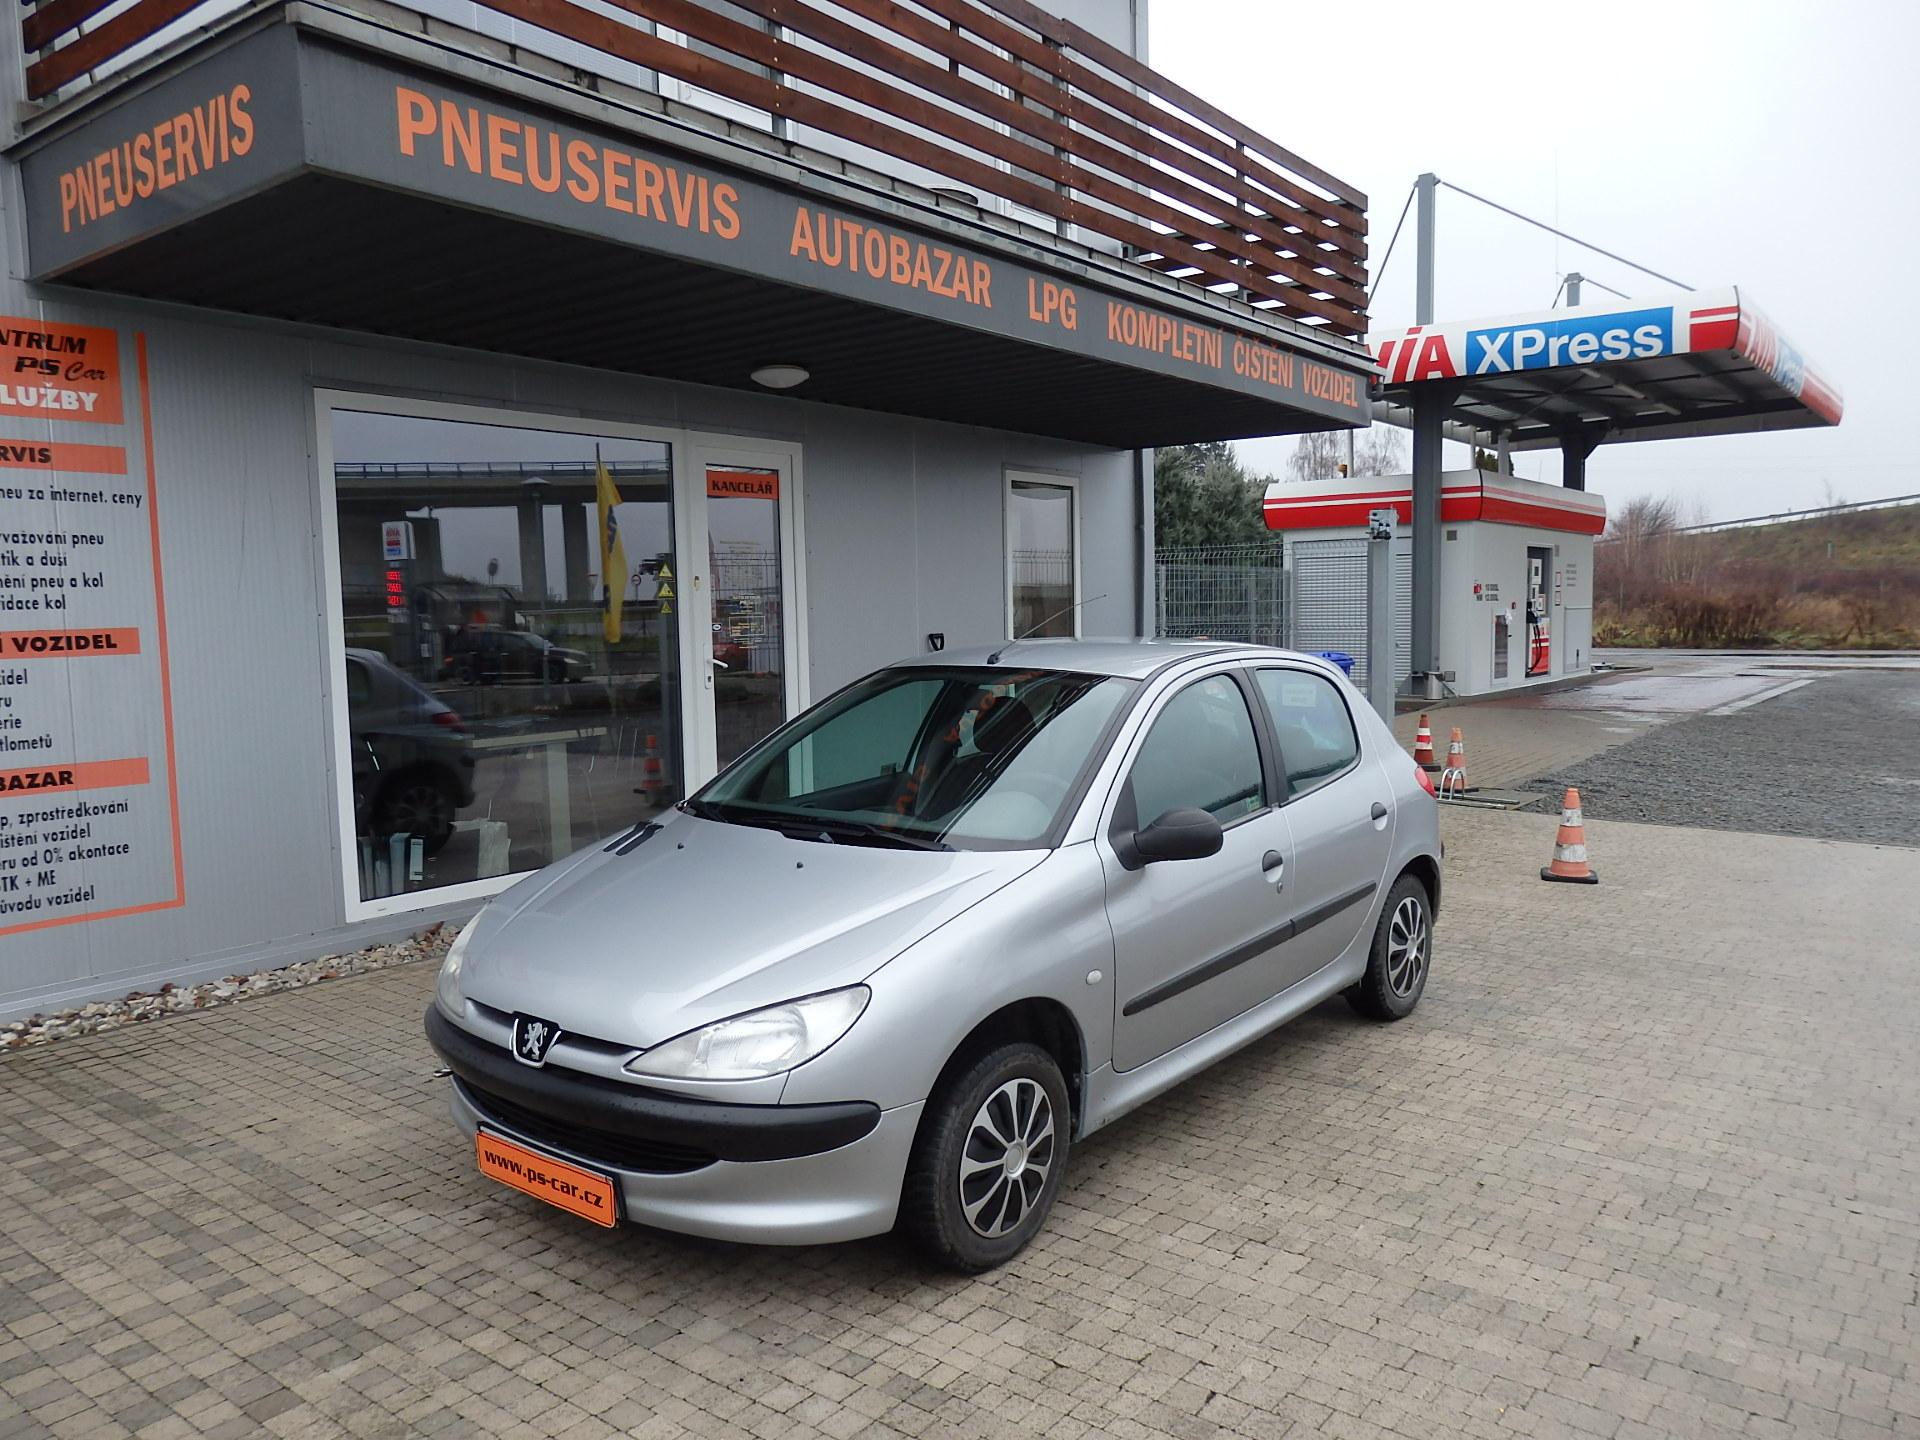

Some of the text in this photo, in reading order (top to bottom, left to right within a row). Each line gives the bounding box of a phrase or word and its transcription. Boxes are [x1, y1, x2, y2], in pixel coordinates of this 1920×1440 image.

[60, 84, 254, 233] PNEUSERVIS
[396, 86, 742, 241] PNEUSERVIS
[790, 207, 993, 308] AUTOBAZAR
[1028, 277, 1078, 330] LPG
[1107, 302, 1223, 369] KOMPLETNÍ
[1302, 362, 1359, 408] VOZIDEL
[1475, 324, 1664, 375] XPress
[14, 356, 106, 381] PS Car
[28, 489, 45, 500] za
[50, 485, 108, 503] internet.
[112, 493, 142, 508] ceny
[0, 531, 104, 548] važování pneu
[26, 556, 34, 566] a
[31, 577, 64, 592] pneu
[70, 577, 77, 588] a
[83, 572, 104, 588] kol
[44, 593, 66, 610] kol
[12, 634, 118, 653] VOZIDEL
[18, 799, 129, 827] zprostředkování
[43, 822, 91, 843] vozidel
[22, 850, 38, 867] od
[44, 847, 63, 864] 0%
[69, 843, 129, 861] akontace
[38, 870, 56, 887] ME
[46, 885, 95, 906] vozidel
[484, 1150, 604, 1209] www.ps-car.cz
